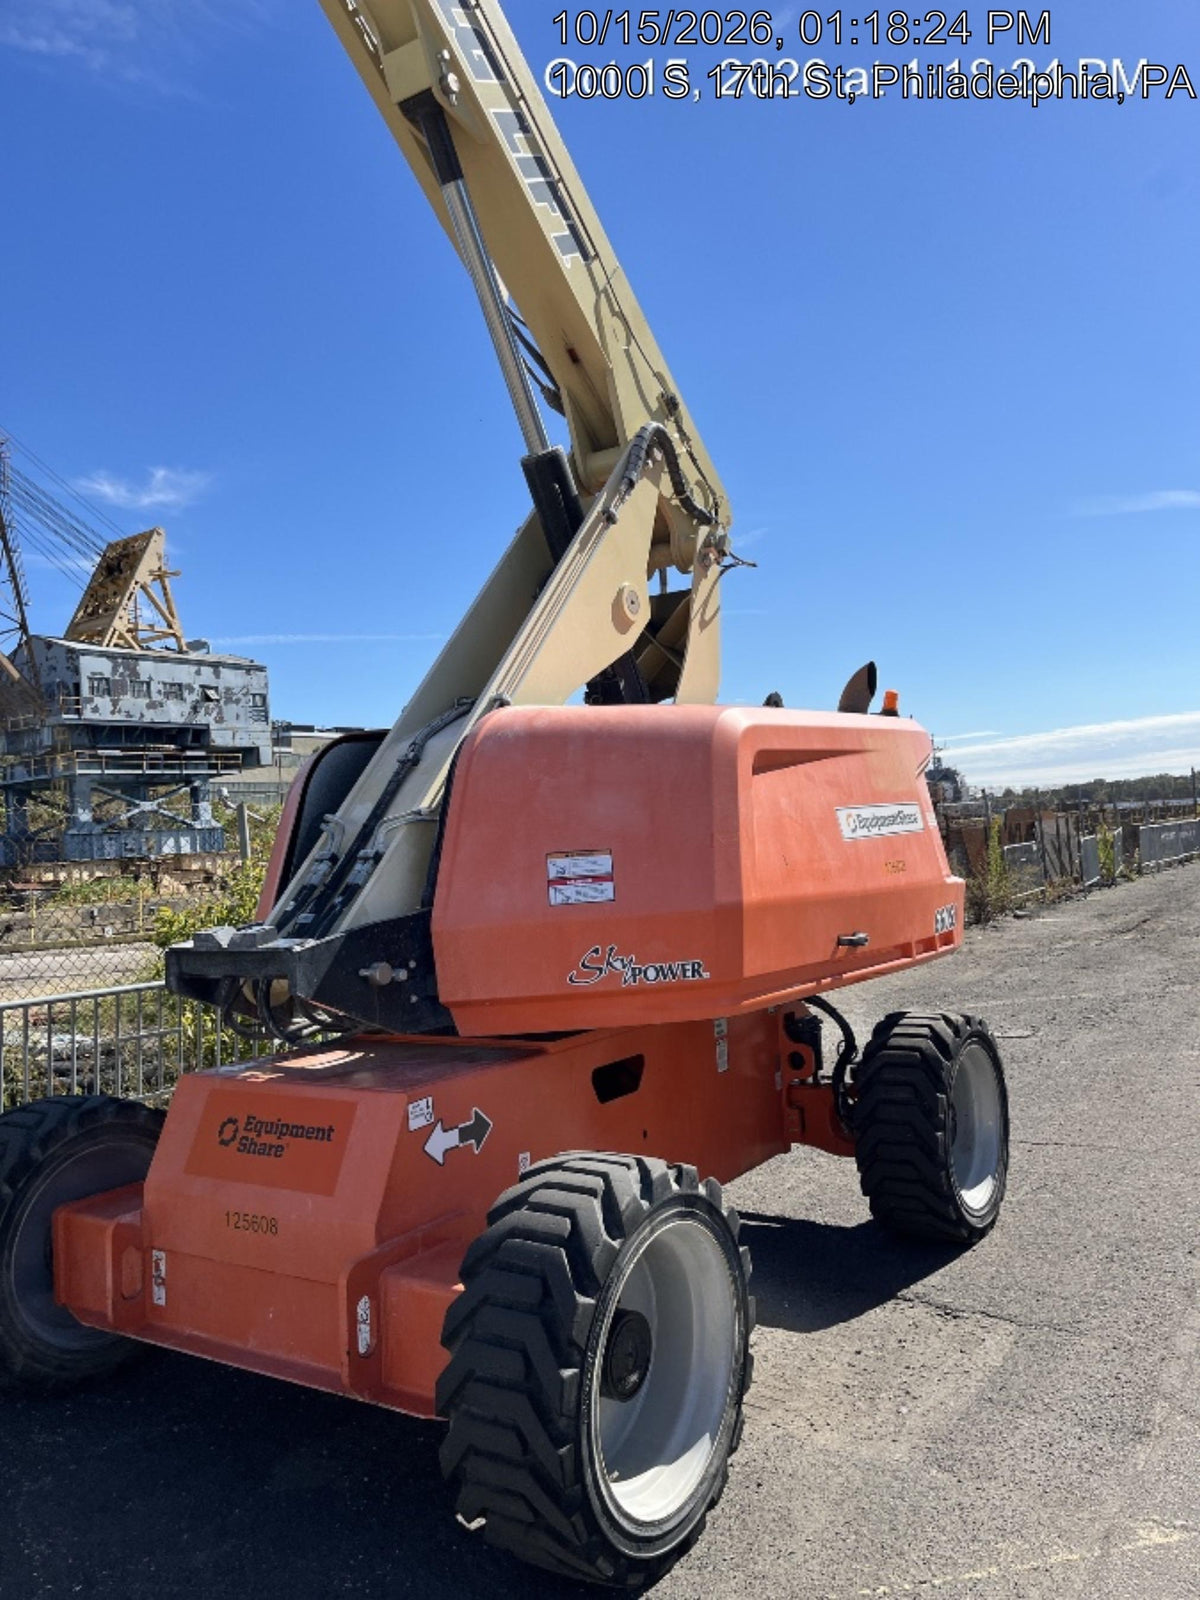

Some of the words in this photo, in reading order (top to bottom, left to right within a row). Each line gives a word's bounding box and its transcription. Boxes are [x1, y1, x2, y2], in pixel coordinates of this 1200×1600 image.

[243, 1115, 335, 1142] Equipment
[236, 1135, 285, 1158] Share
[225, 1210, 278, 1235] 125608
